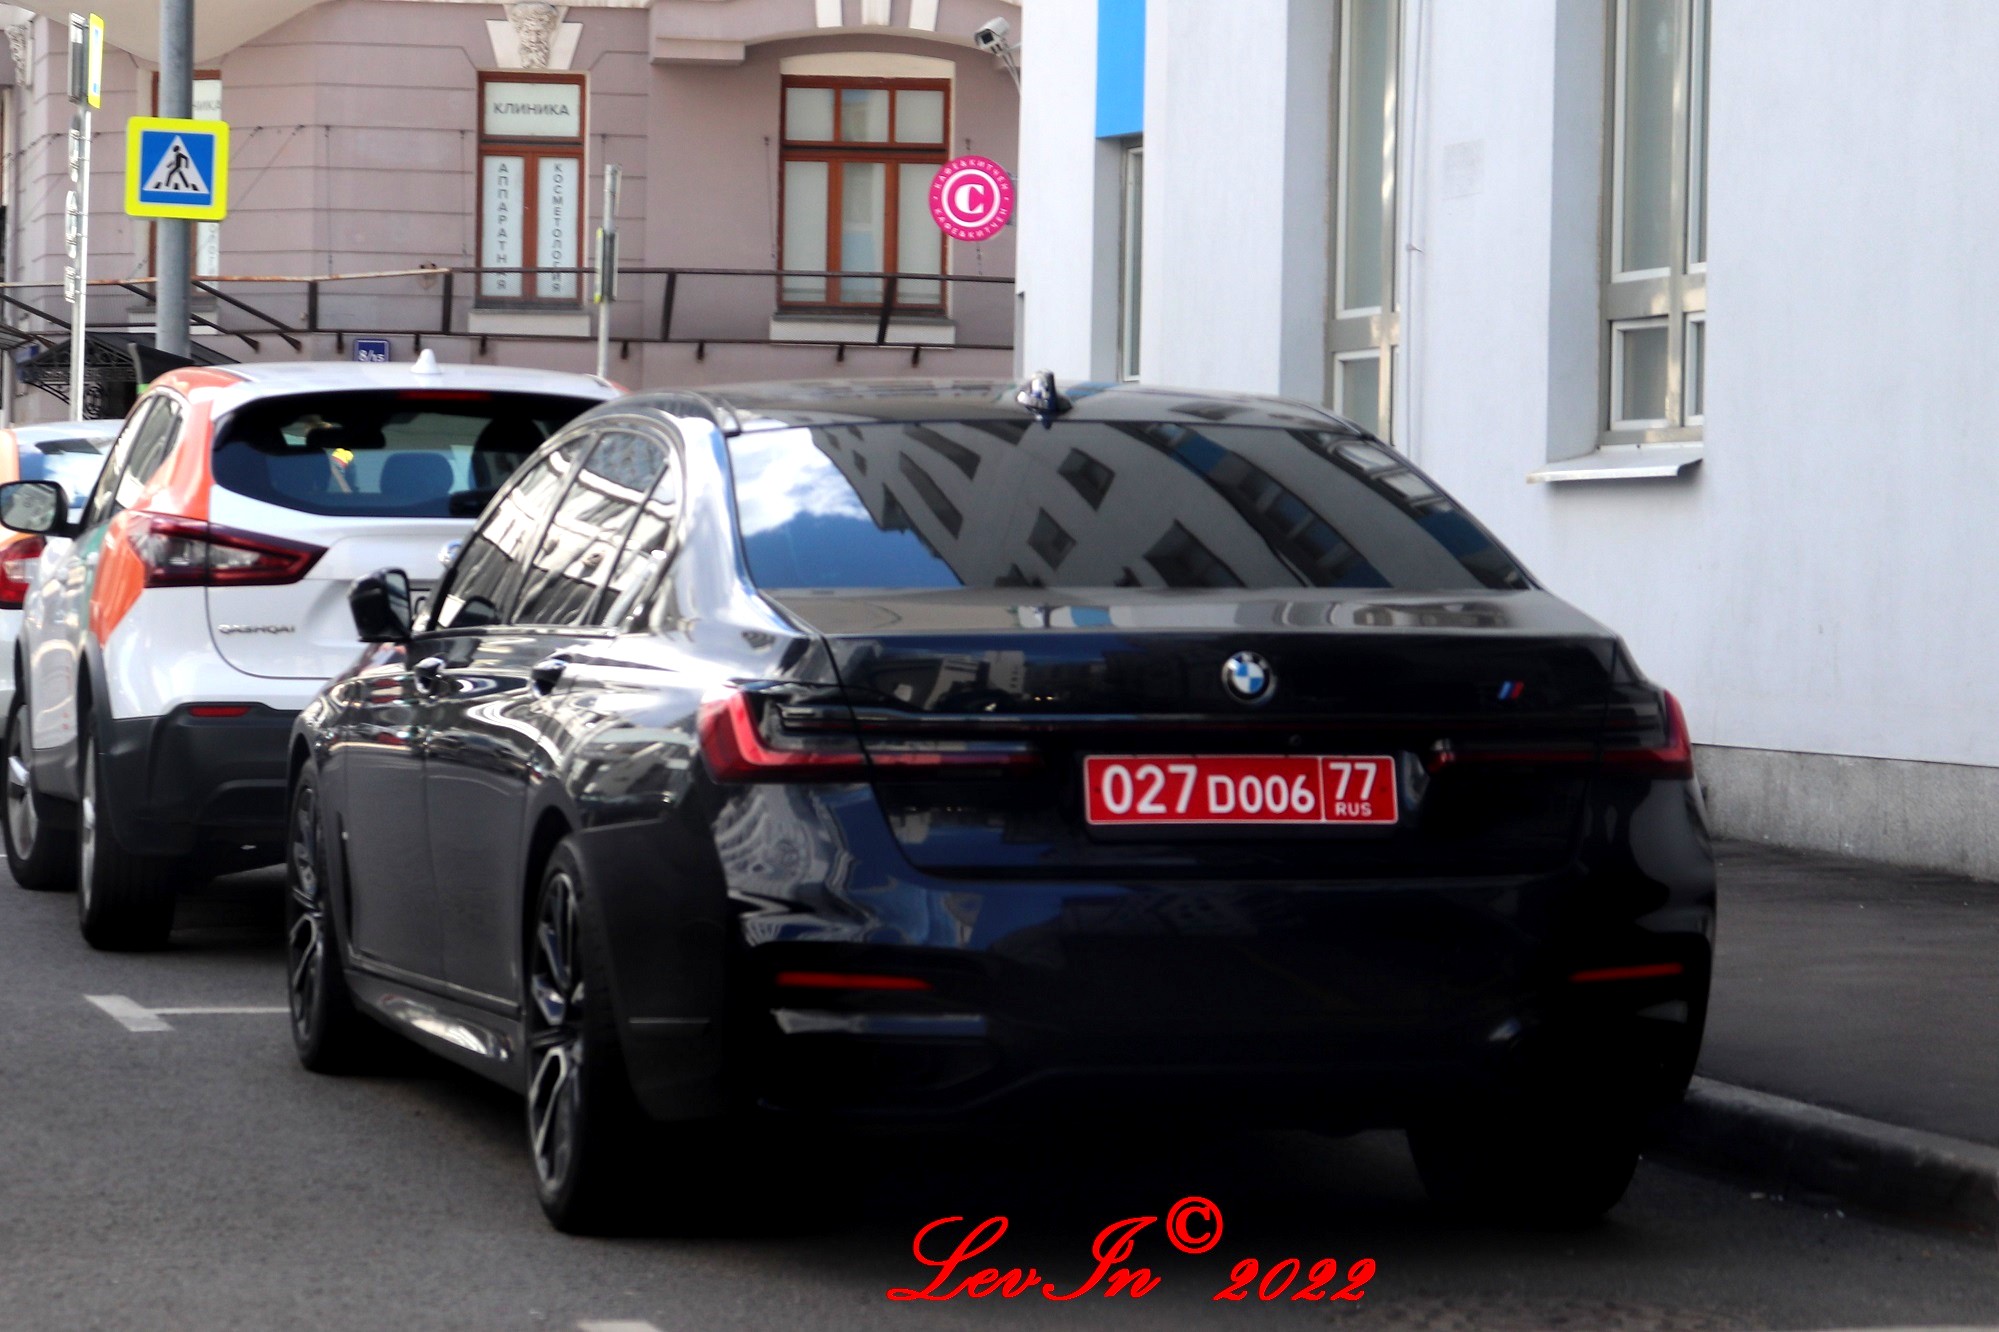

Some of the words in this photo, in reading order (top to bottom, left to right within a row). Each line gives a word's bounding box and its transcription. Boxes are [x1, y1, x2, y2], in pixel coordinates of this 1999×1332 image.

[493, 102, 570, 116] КЛИНИКА
[217, 624, 295, 635] QASHQAI
[1329, 763, 1377, 800] 77
[1335, 802, 1372, 816] RUS
